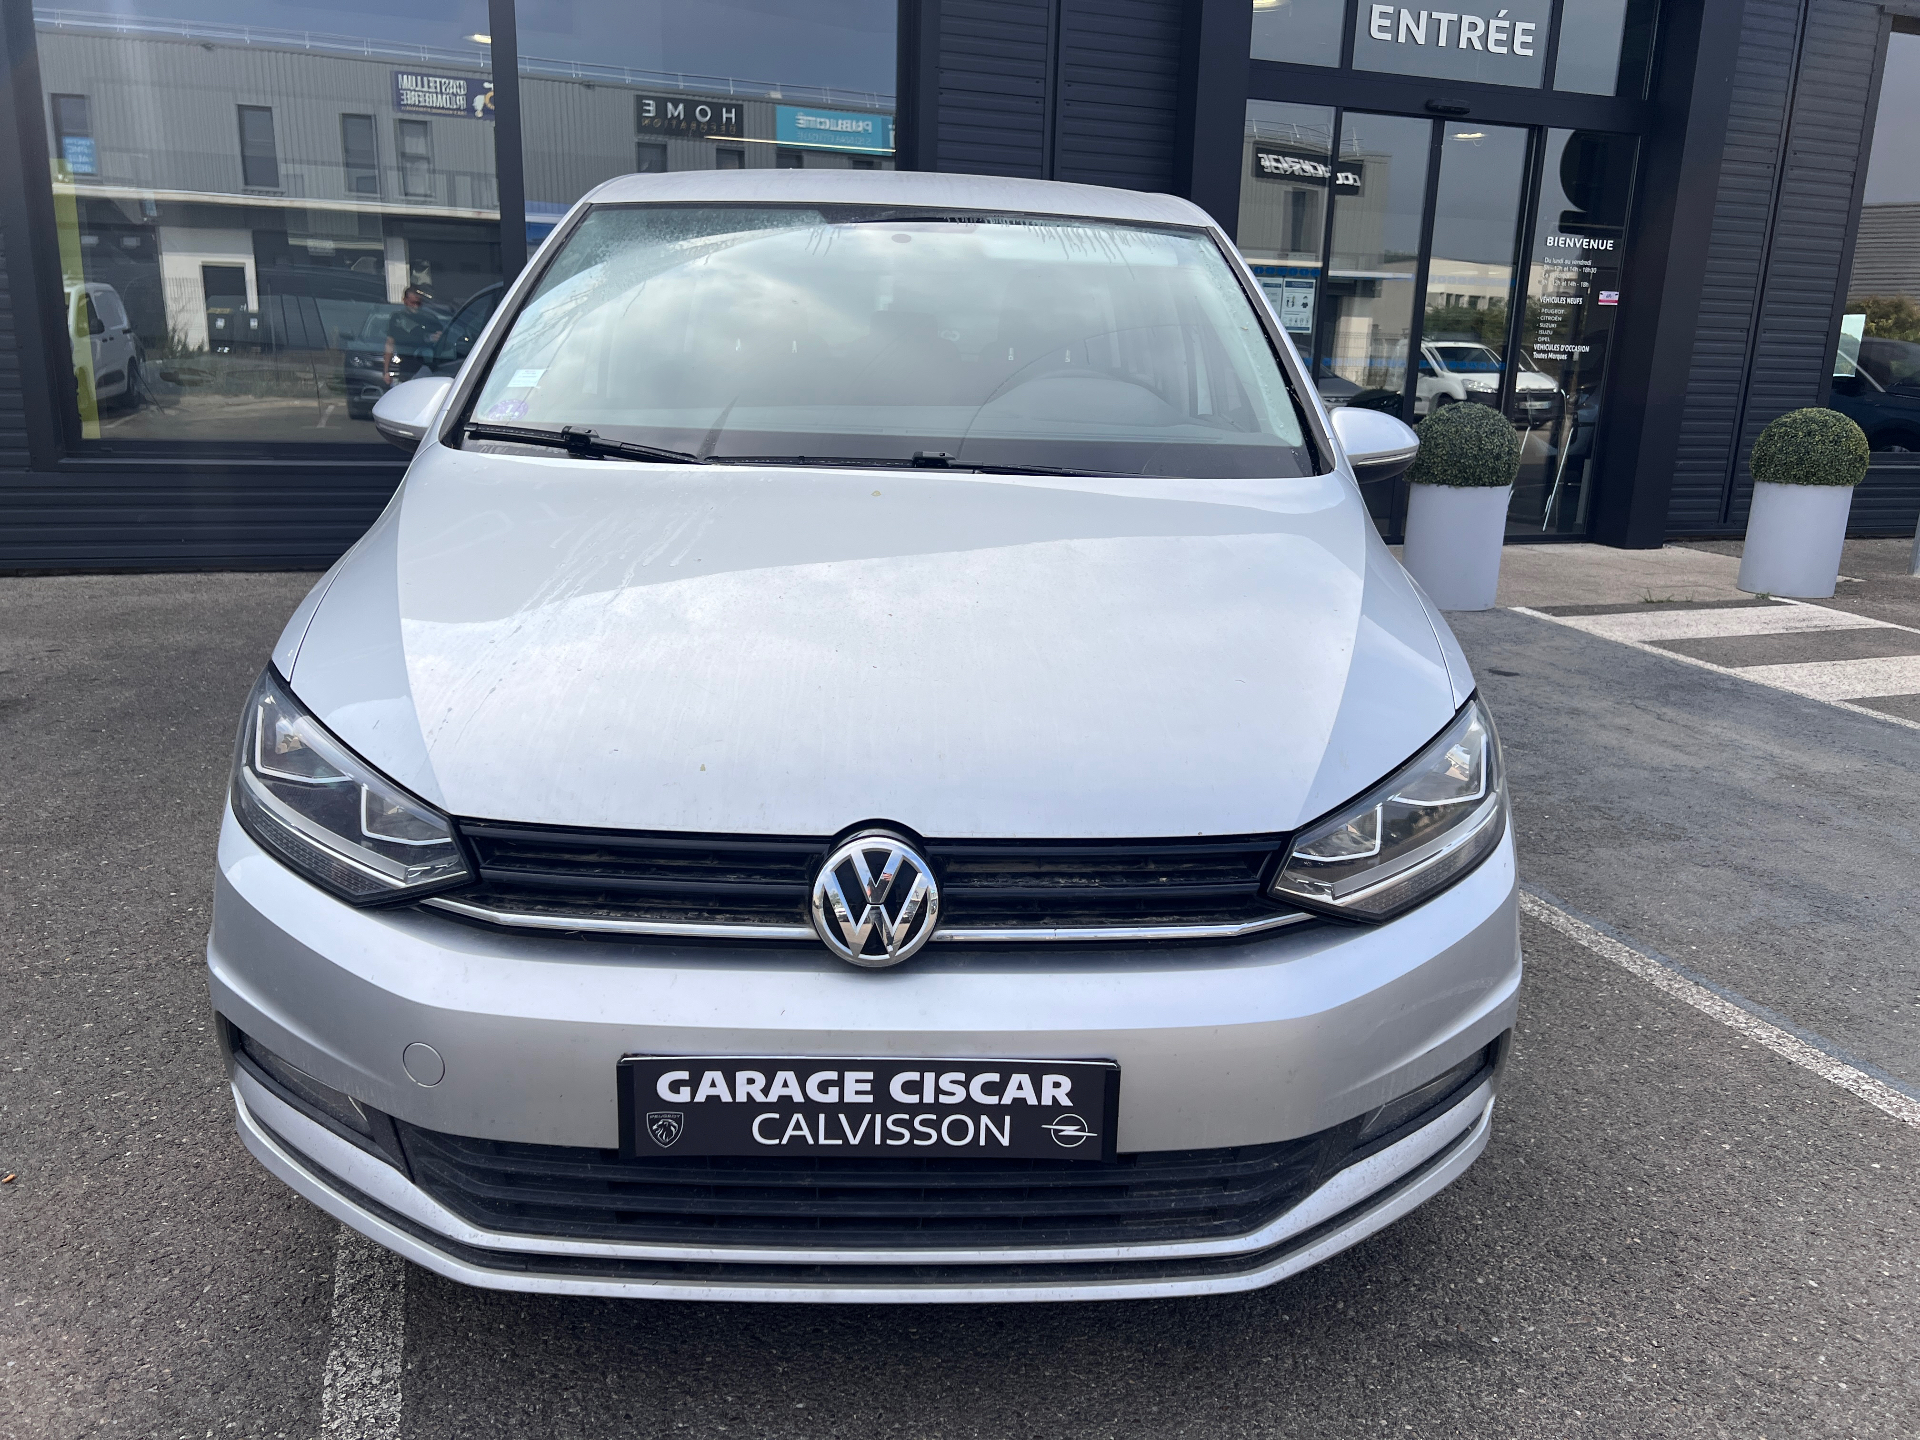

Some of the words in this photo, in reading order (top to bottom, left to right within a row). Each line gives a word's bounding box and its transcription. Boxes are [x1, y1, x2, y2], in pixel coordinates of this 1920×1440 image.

[1370, 4, 1536, 57] ENTRÉE
[1546, 236, 1614, 250] BIENVENUE
[1547, 353, 1567, 361] Marques
[656, 1070, 875, 1103] GARAGE
[888, 1072, 1074, 1107] CISCAR
[751, 1113, 1011, 1147] CALVISSON
